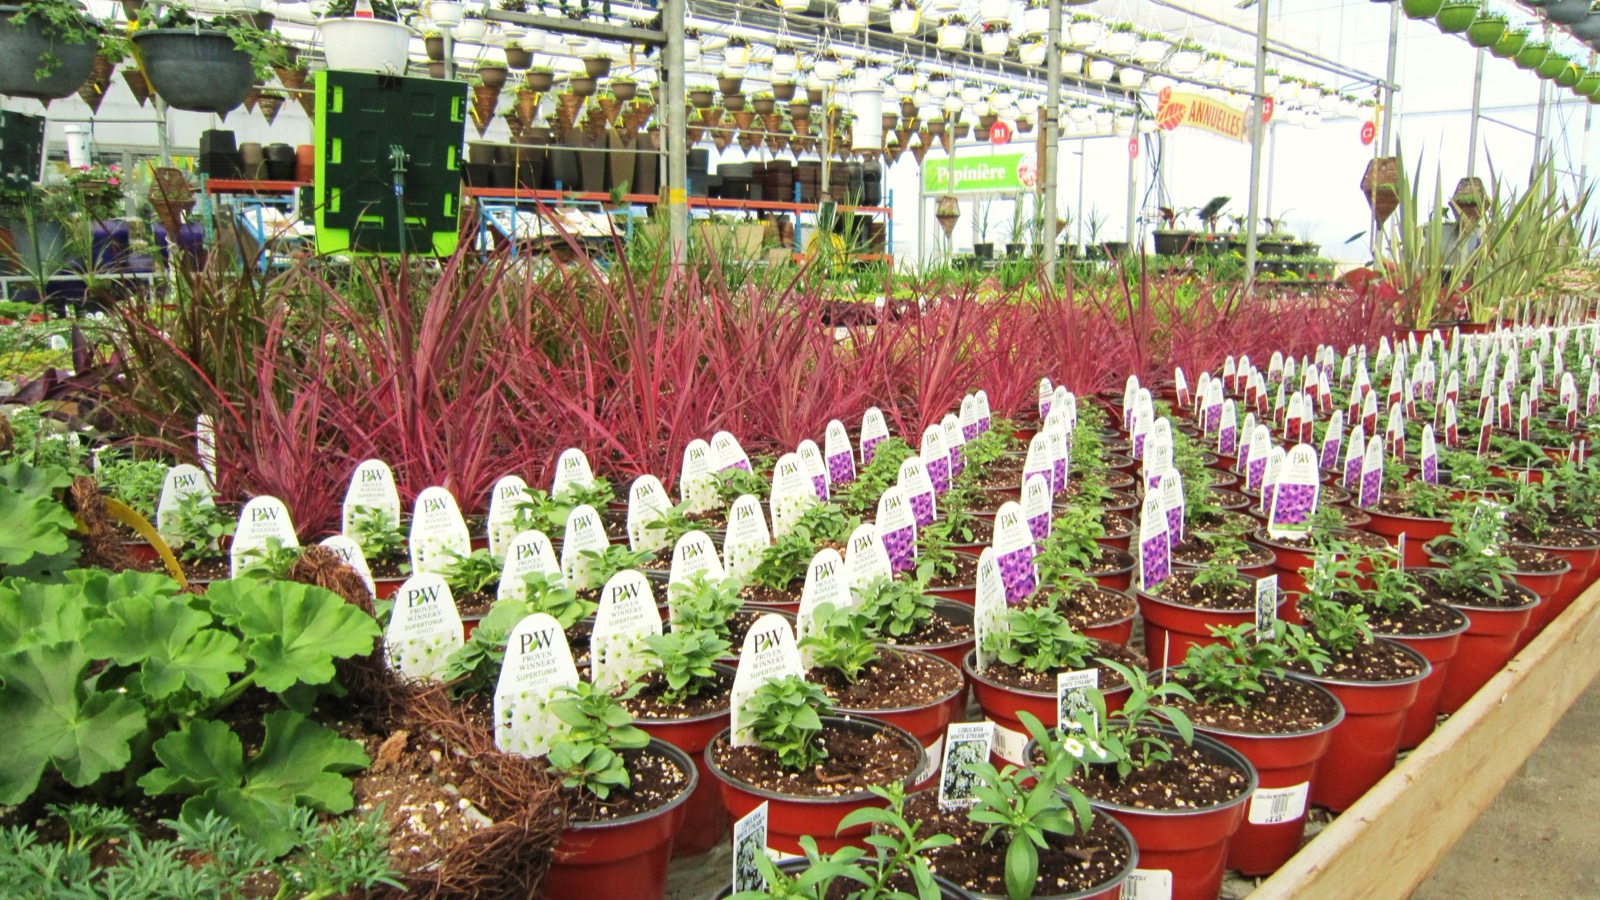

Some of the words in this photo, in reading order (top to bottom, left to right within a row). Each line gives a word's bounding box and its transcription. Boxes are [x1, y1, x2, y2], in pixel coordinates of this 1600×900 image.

[1187, 100, 1242, 137] ANNUELLES
[994, 129, 1005, 139] B1
[690, 446, 706, 461] PW
[564, 456, 582, 470] PW
[780, 460, 800, 477] PW
[362, 469, 386, 482] PW
[904, 464, 922, 480] PW
[173, 473, 197, 490] PW
[500, 484, 521, 500] PW
[636, 481, 655, 500] PW
[424, 496, 448, 513] PW
[884, 493, 904, 512] PW
[252, 507, 280, 522] PW
[736, 503, 756, 520] PW
[574, 513, 594, 532] PW
[1000, 510, 1020, 530] PW
[516, 541, 544, 560] PW
[682, 540, 706, 560] PW
[854, 532, 874, 554] PW
[815, 560, 838, 582] PW
[408, 584, 441, 608] PW
[612, 581, 642, 604] PW
[410, 604, 438, 615] PROVEN
[611, 606, 642, 618] WINNERS
[614, 600, 640, 611] PROVEN
[407, 610, 442, 622] WINNERS
[609, 614, 644, 627] SUPERTUNIA
[404, 618, 444, 632] SUPERTUNIA
[520, 628, 555, 655] PW
[754, 627, 784, 654] PW
[522, 651, 552, 663] PROVEN
[752, 656, 786, 670] WINNERS
[756, 649, 782, 662] PROVEN
[519, 658, 556, 672] WINNERS
[750, 664, 786, 680] SUPERTUNIA
[516, 667, 558, 682] SUPERTUNIA
